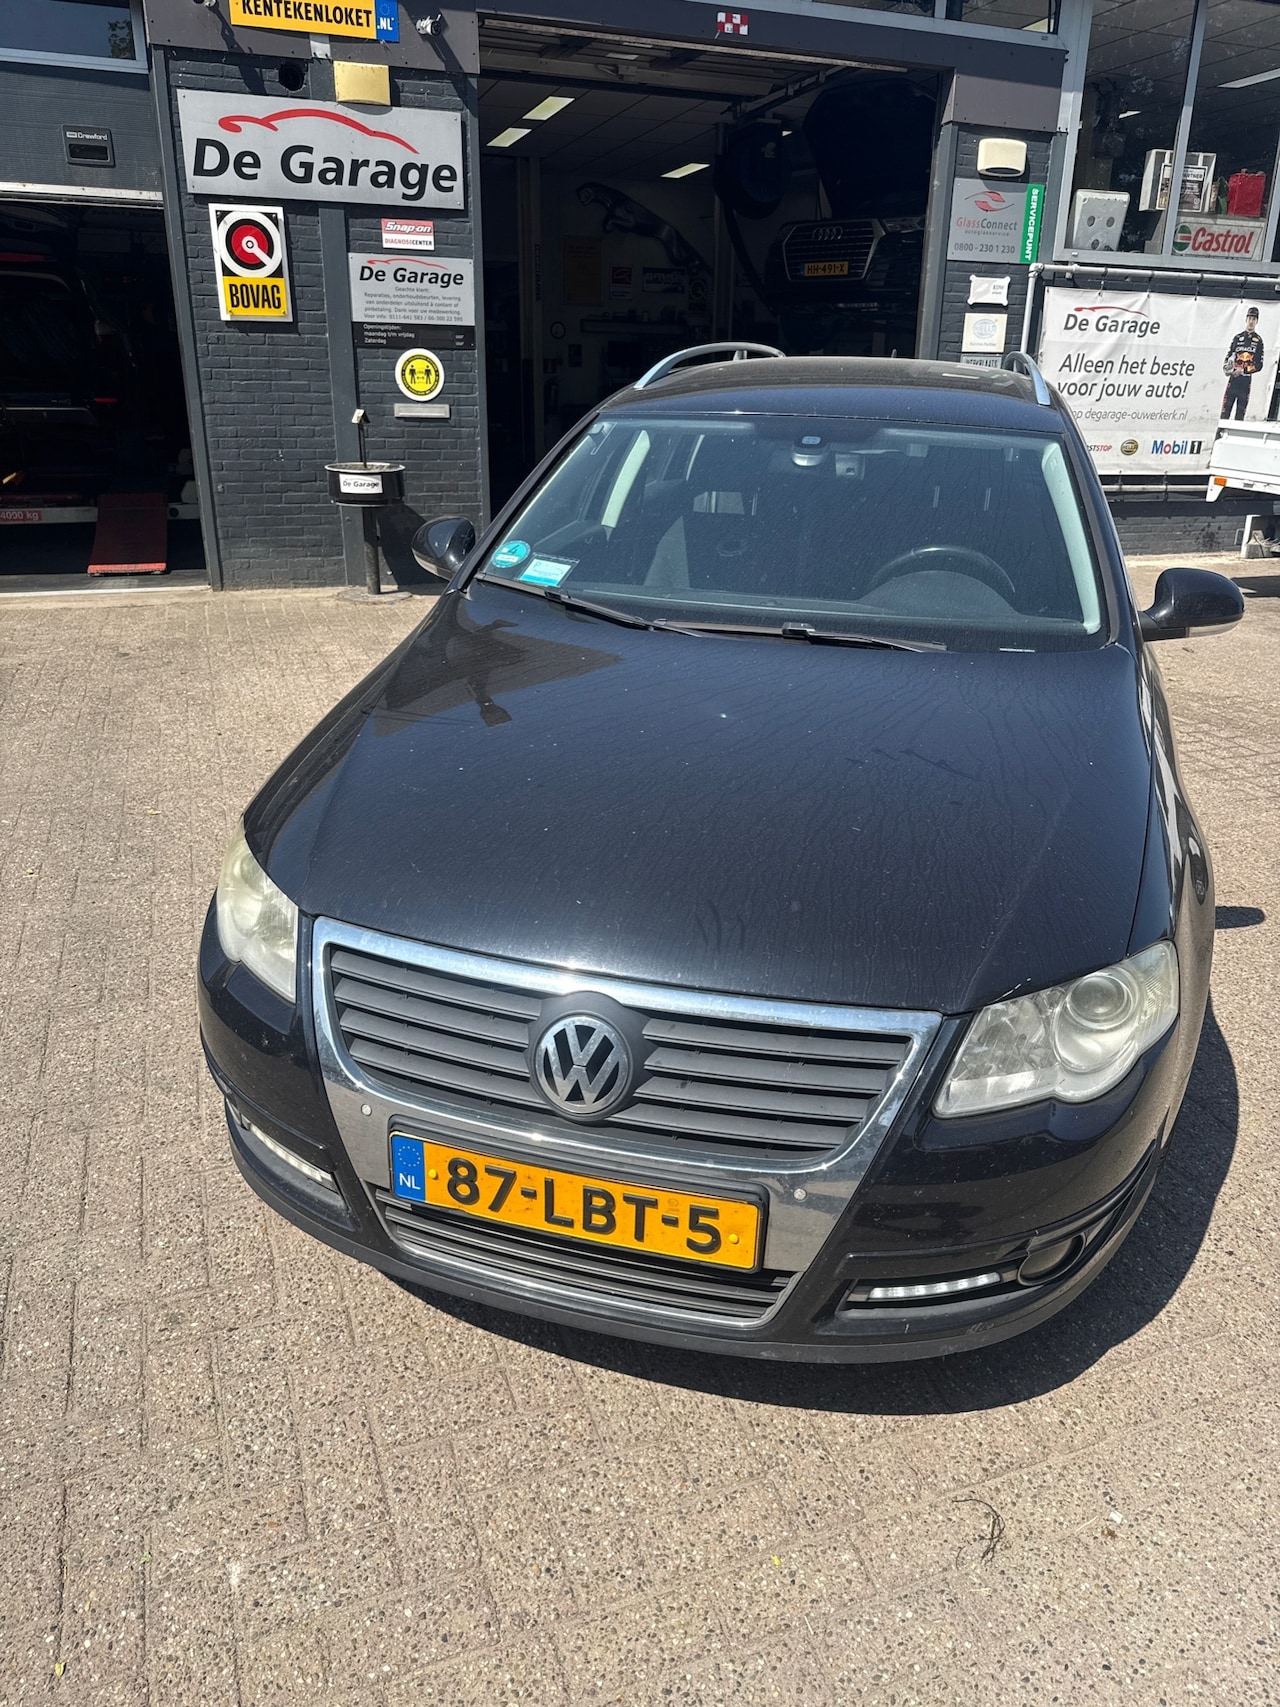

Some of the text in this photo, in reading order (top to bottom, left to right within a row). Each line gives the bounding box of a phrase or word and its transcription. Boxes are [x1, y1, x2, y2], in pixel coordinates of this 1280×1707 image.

[242, 0, 372, 27] KENTEKENLOKET
[193, 138, 457, 201] De Garage
[956, 217, 1018, 231] GlassConnect
[1024, 188, 1040, 261] SERVICEPUNT
[954, 243, 973, 252] 0800
[979, 243, 994, 252] 230
[1001, 245, 1015, 254] 230
[1191, 227, 1254, 254] Castrol
[359, 266, 464, 288] De Garage
[807, 264, 845, 275] HH-491-X
[229, 283, 282, 310] BOVAG
[1063, 313, 1160, 338] De Garage
[1058, 353, 1195, 377] Alleen het beste
[1057, 378, 1189, 402] voor jouw auto!
[1085, 408, 1188, 422] degarage-ouwerkerk.nl
[1151, 440, 1188, 454] Mobil
[342, 480, 380, 488] De Garage
[26, 512, 38, 521] kg
[399, 1173, 421, 1190] NL
[447, 1157, 722, 1255] 87-LBT-5
